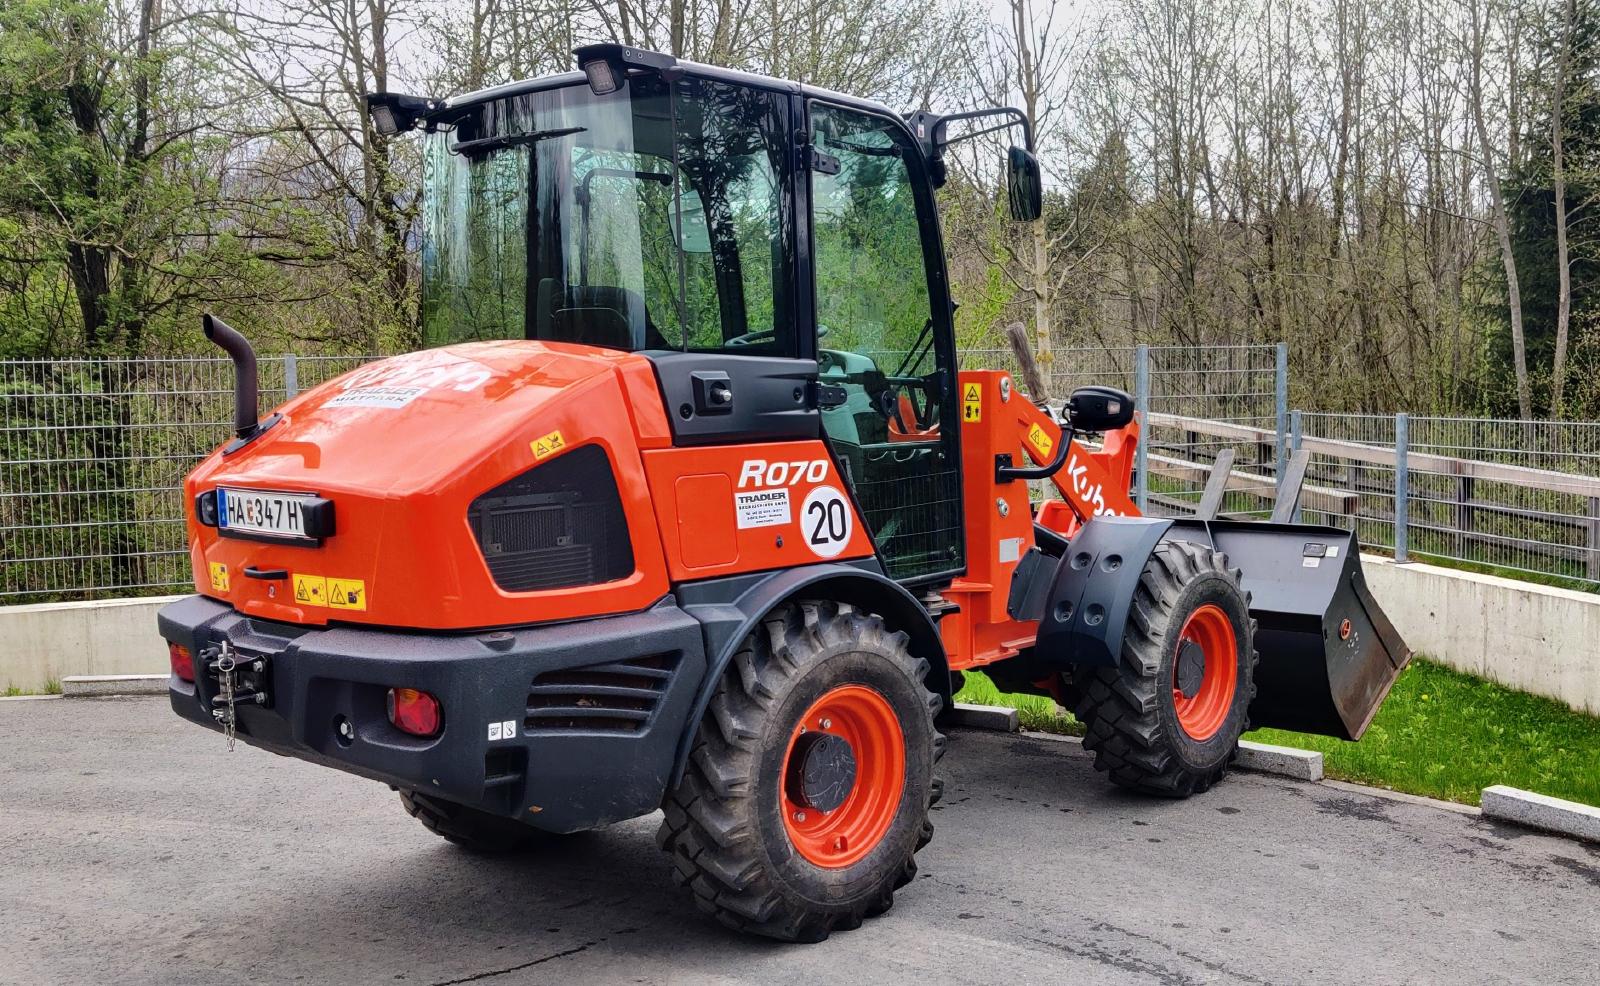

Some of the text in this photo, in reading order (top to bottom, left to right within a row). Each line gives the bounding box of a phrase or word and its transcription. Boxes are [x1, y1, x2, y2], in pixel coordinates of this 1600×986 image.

[738, 492, 786, 504] TRADLER
[1067, 453, 1125, 517] Kub
[227, 495, 245, 525] HA
[255, 497, 282, 529] 347
[808, 498, 846, 545] 20
